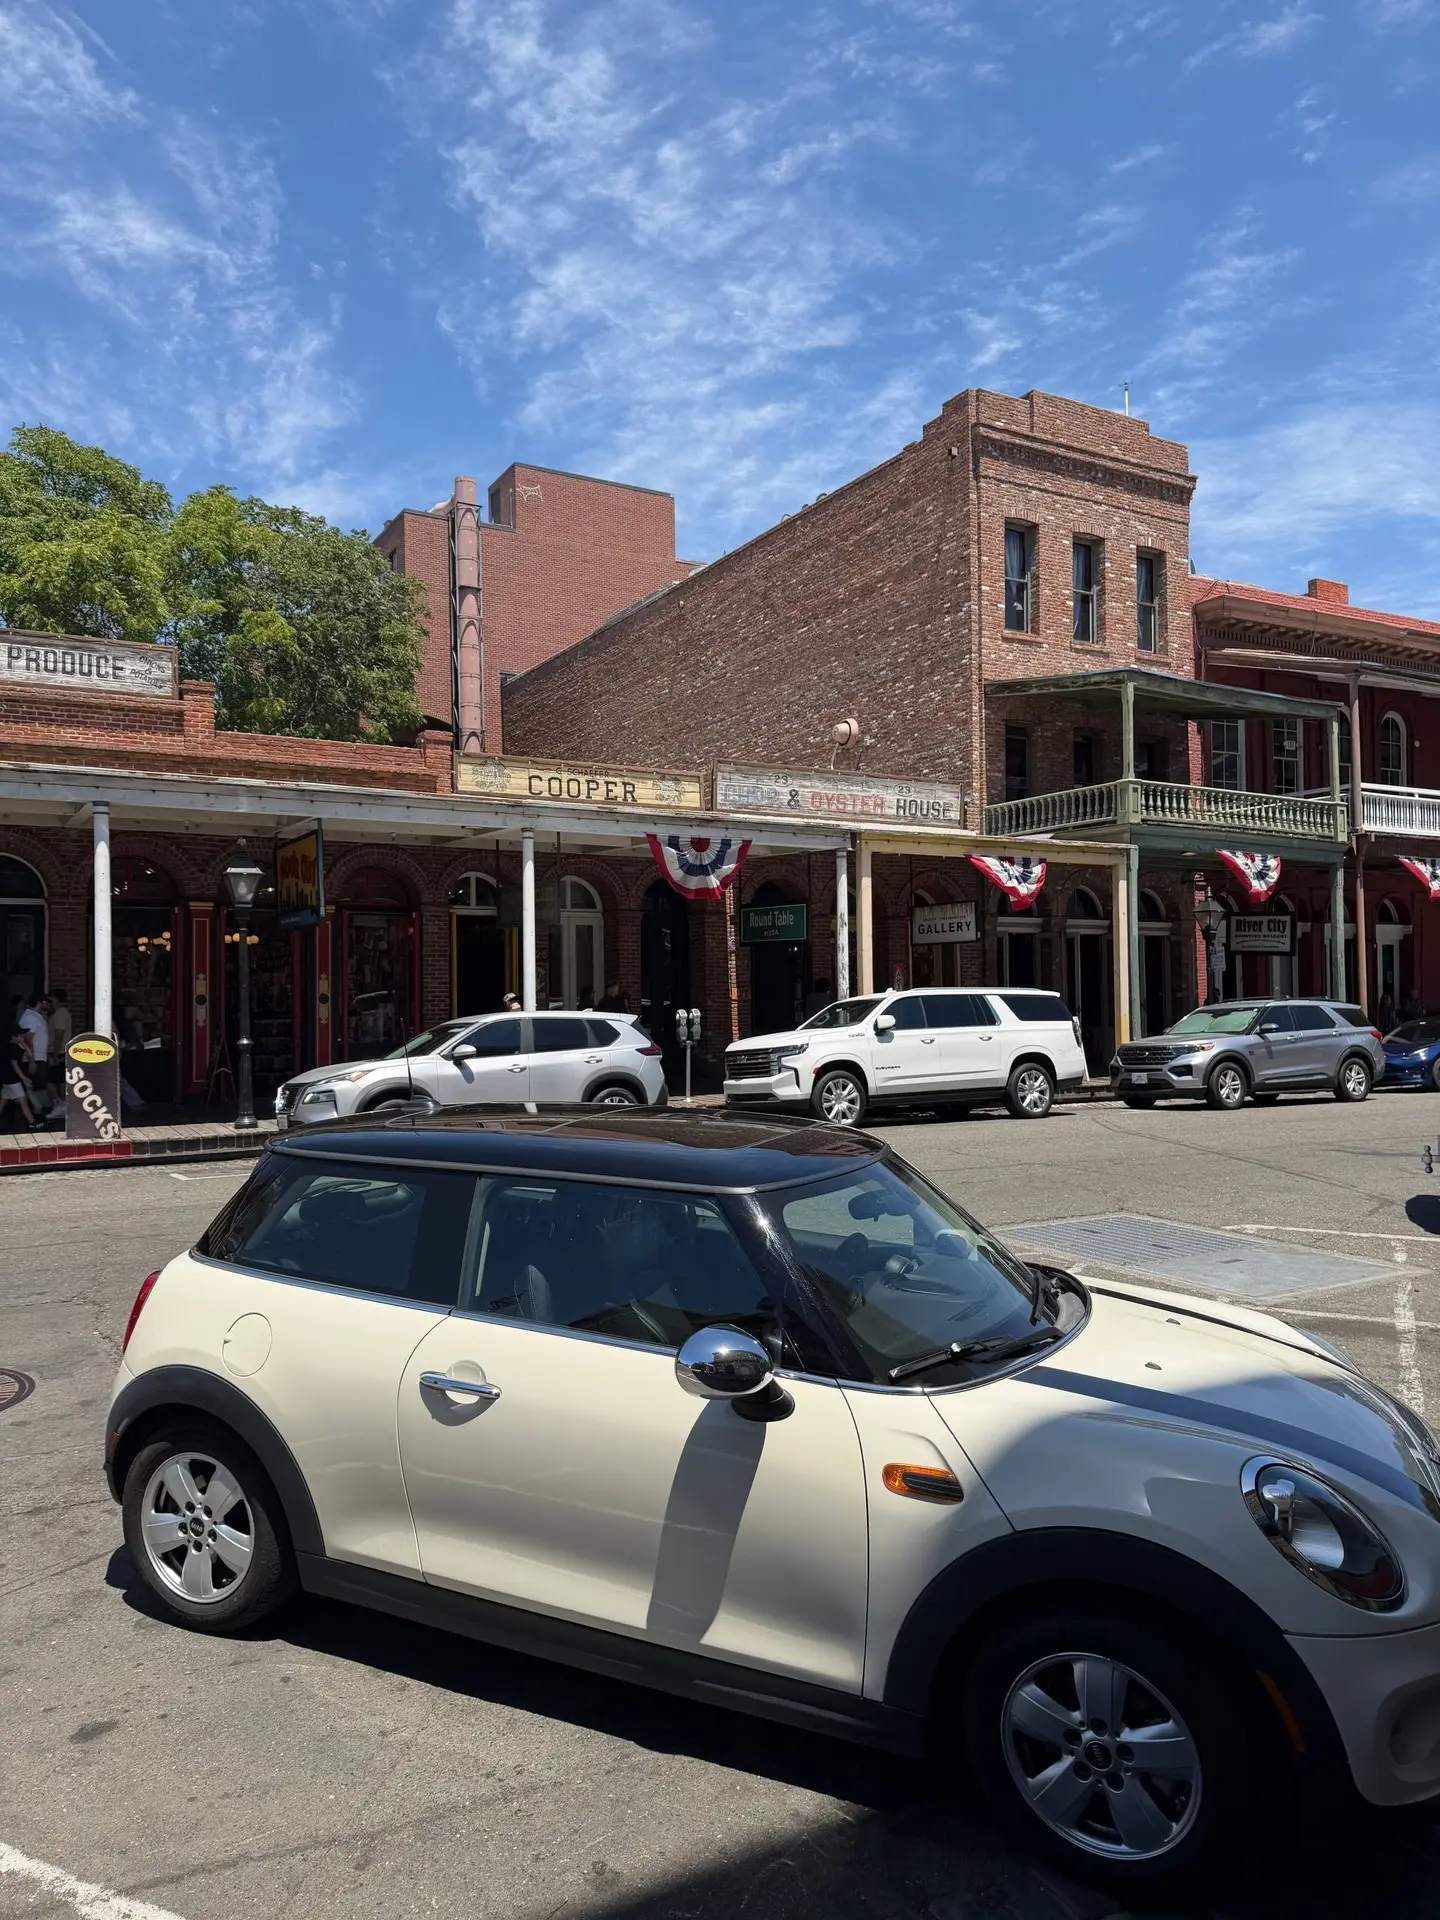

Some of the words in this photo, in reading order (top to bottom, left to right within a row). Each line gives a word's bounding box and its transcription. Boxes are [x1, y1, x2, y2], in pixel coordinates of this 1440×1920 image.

[7, 645, 126, 681] PRODUCE
[140, 655, 167, 673] ONIONS
[567, 767, 610, 778] SCHAEFER
[774, 774, 788, 785] 23
[528, 774, 638, 802] COOPER
[897, 785, 911, 795] 23
[787, 788, 800, 809] &
[811, 791, 885, 815] OYSTER
[895, 797, 953, 819] HOUSE
[749, 911, 772, 927] Round
[774, 910, 794, 926] Table
[1235, 918, 1264, 932] River
[1266, 918, 1288, 934] City
[763, 929, 779, 937] PIZZA
[917, 921, 972, 935] GALLERY
[66, 1066, 119, 1139] SOCKS
